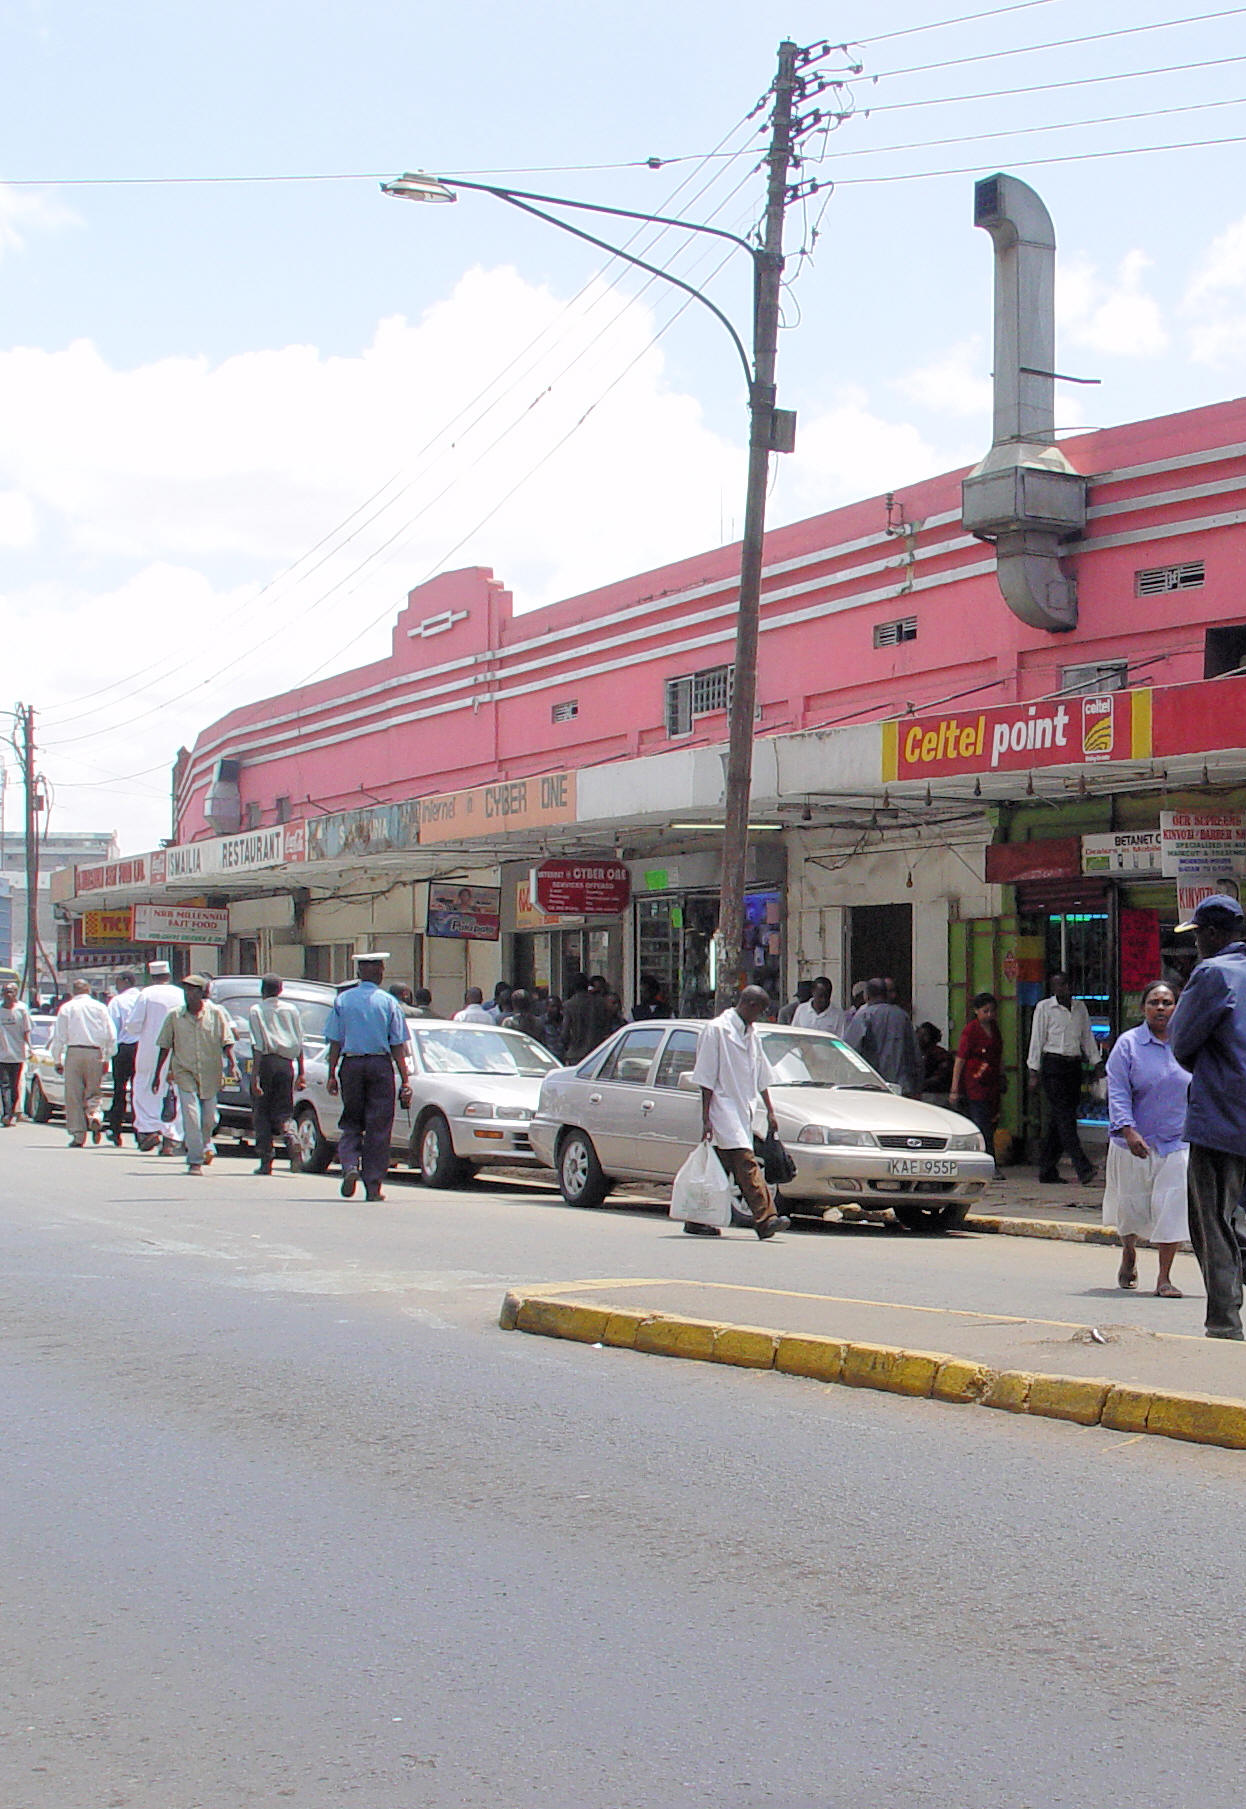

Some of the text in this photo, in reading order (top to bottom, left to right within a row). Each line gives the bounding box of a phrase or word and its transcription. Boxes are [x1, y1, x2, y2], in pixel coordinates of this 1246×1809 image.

[1085, 698, 1111, 715] celtel
[904, 704, 1069, 768] Celtel point
[485, 781, 528, 818] CYBER
[541, 774, 567, 809] ONE
[170, 845, 202, 877] ISMAILIA
[222, 832, 281, 868] RESTAURANT
[1114, 833, 1153, 847] BETANET
[891, 1160, 957, 1175] KAE 955P
